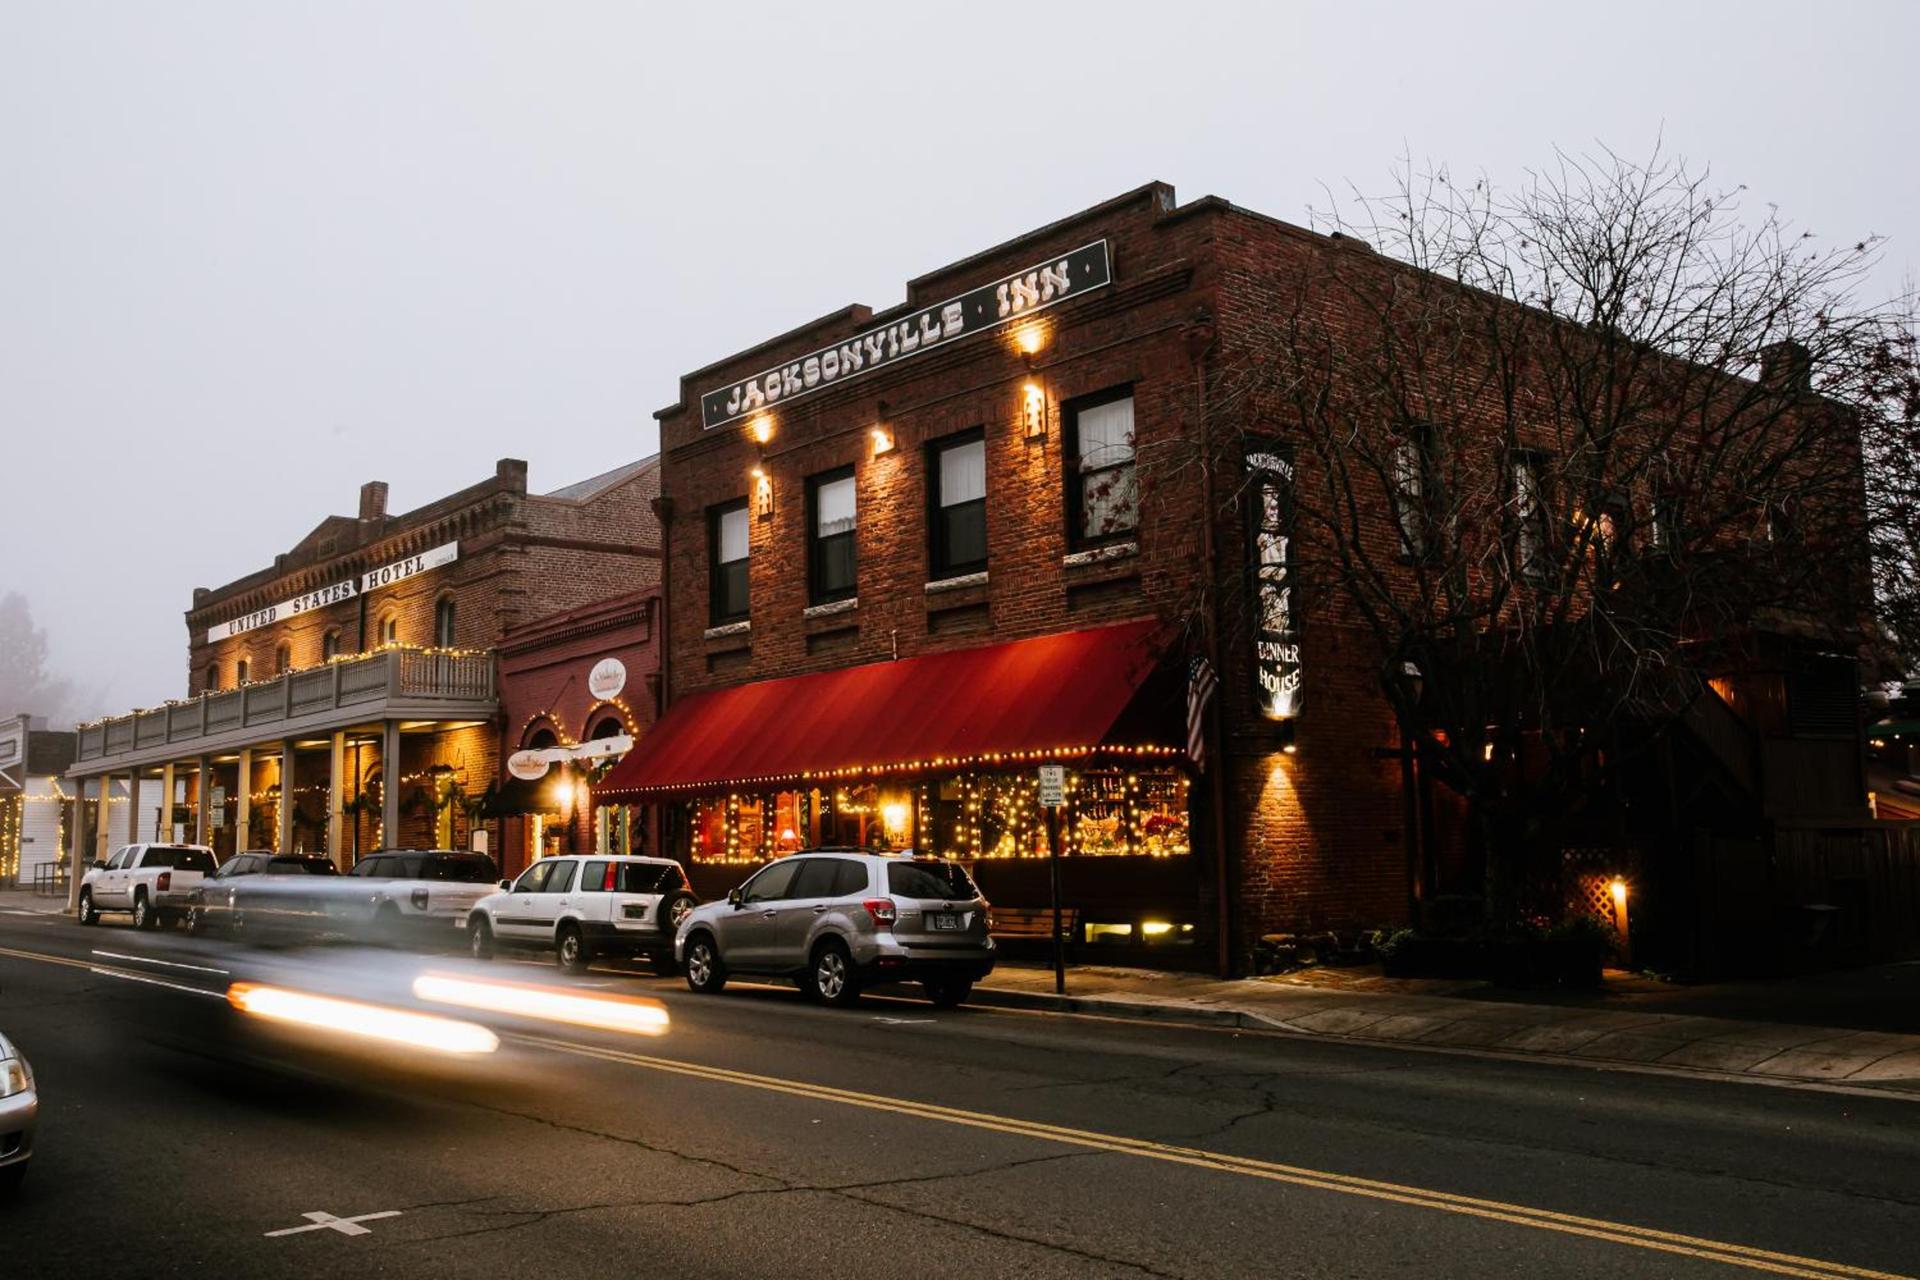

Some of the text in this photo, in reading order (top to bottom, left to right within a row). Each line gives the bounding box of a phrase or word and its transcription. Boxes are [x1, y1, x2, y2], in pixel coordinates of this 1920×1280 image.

[726, 259, 1071, 416] JACKSONVILLE INN
[229, 607, 277, 635] UNITED
[293, 582, 351, 614] STATES
[368, 555, 425, 590] HOTEL
[1257, 640, 1300, 664] DINNER
[1259, 665, 1300, 695] HOUSE
